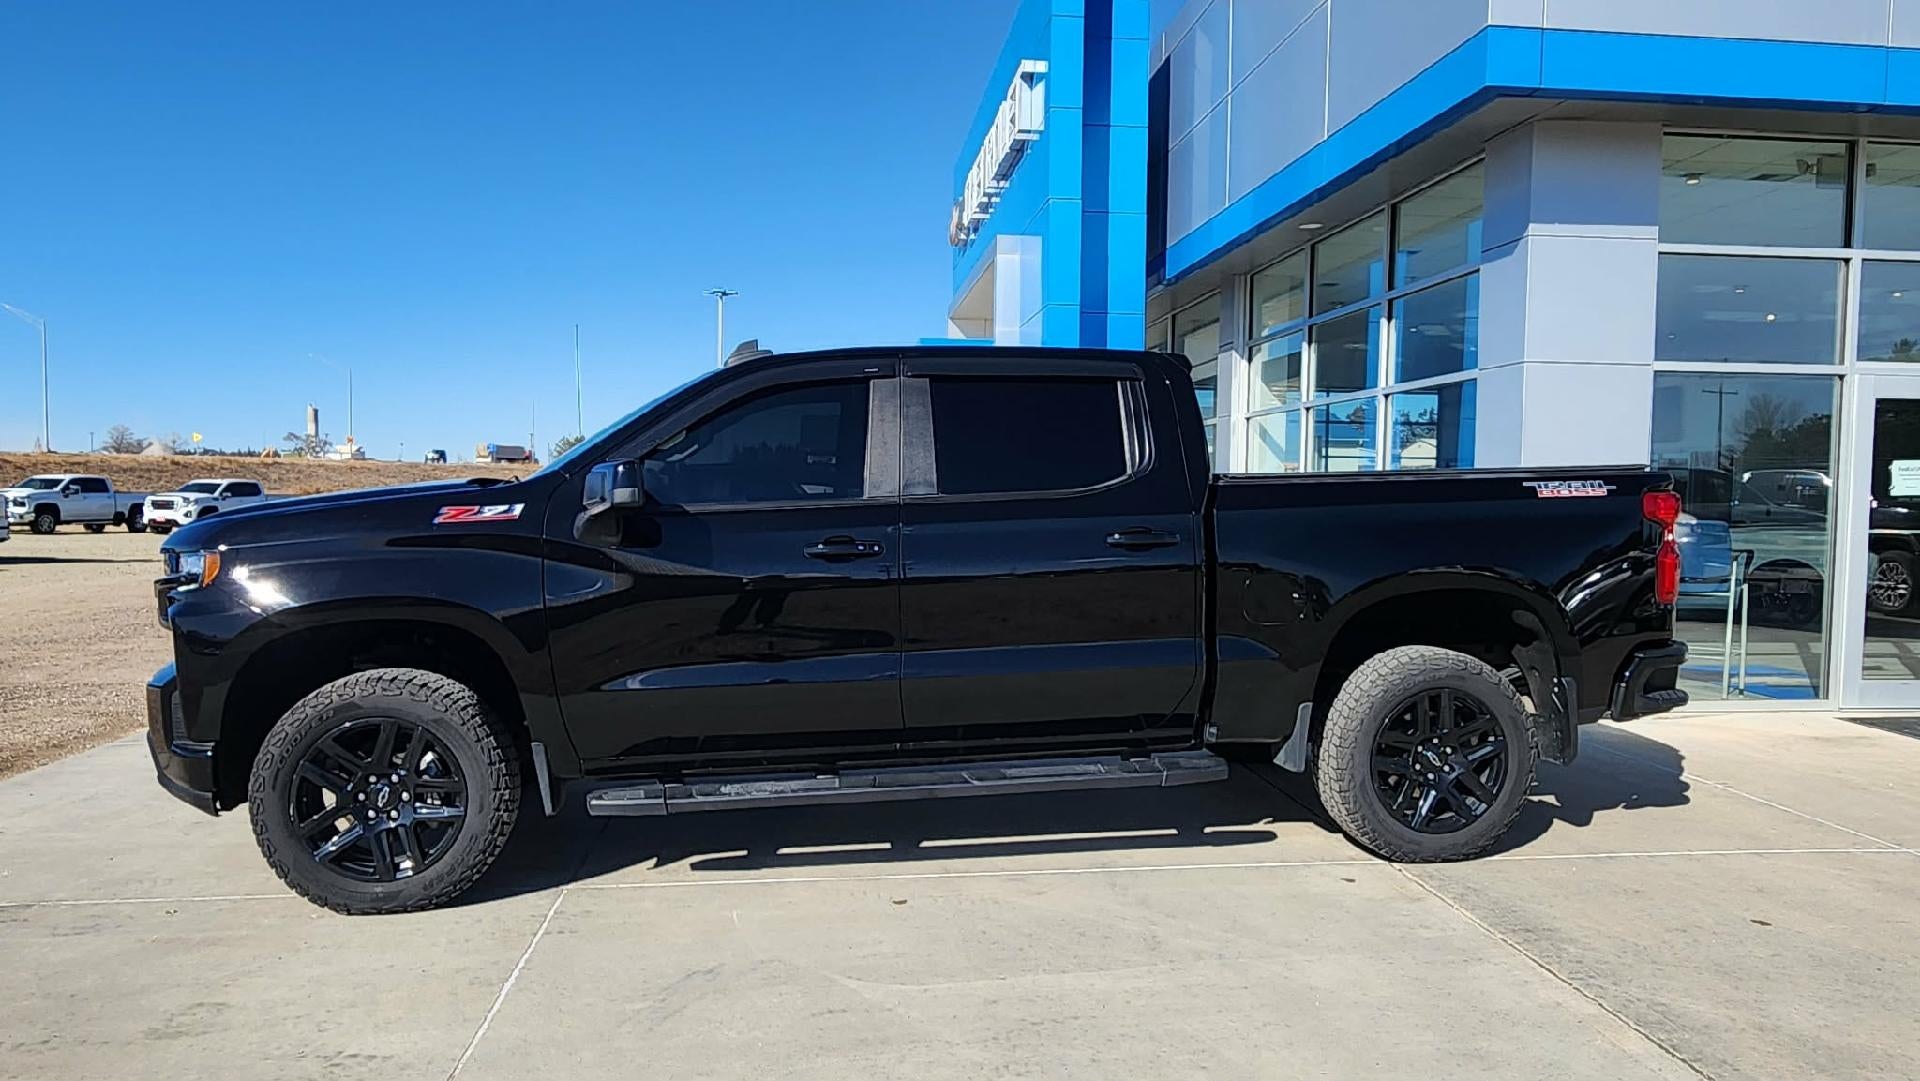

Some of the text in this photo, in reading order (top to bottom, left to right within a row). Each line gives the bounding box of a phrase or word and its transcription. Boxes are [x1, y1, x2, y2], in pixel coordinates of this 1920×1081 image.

[1523, 480, 1617, 490] TRAIL
[1537, 488, 1608, 498] BOSS
[432, 502, 526, 524] Z71
